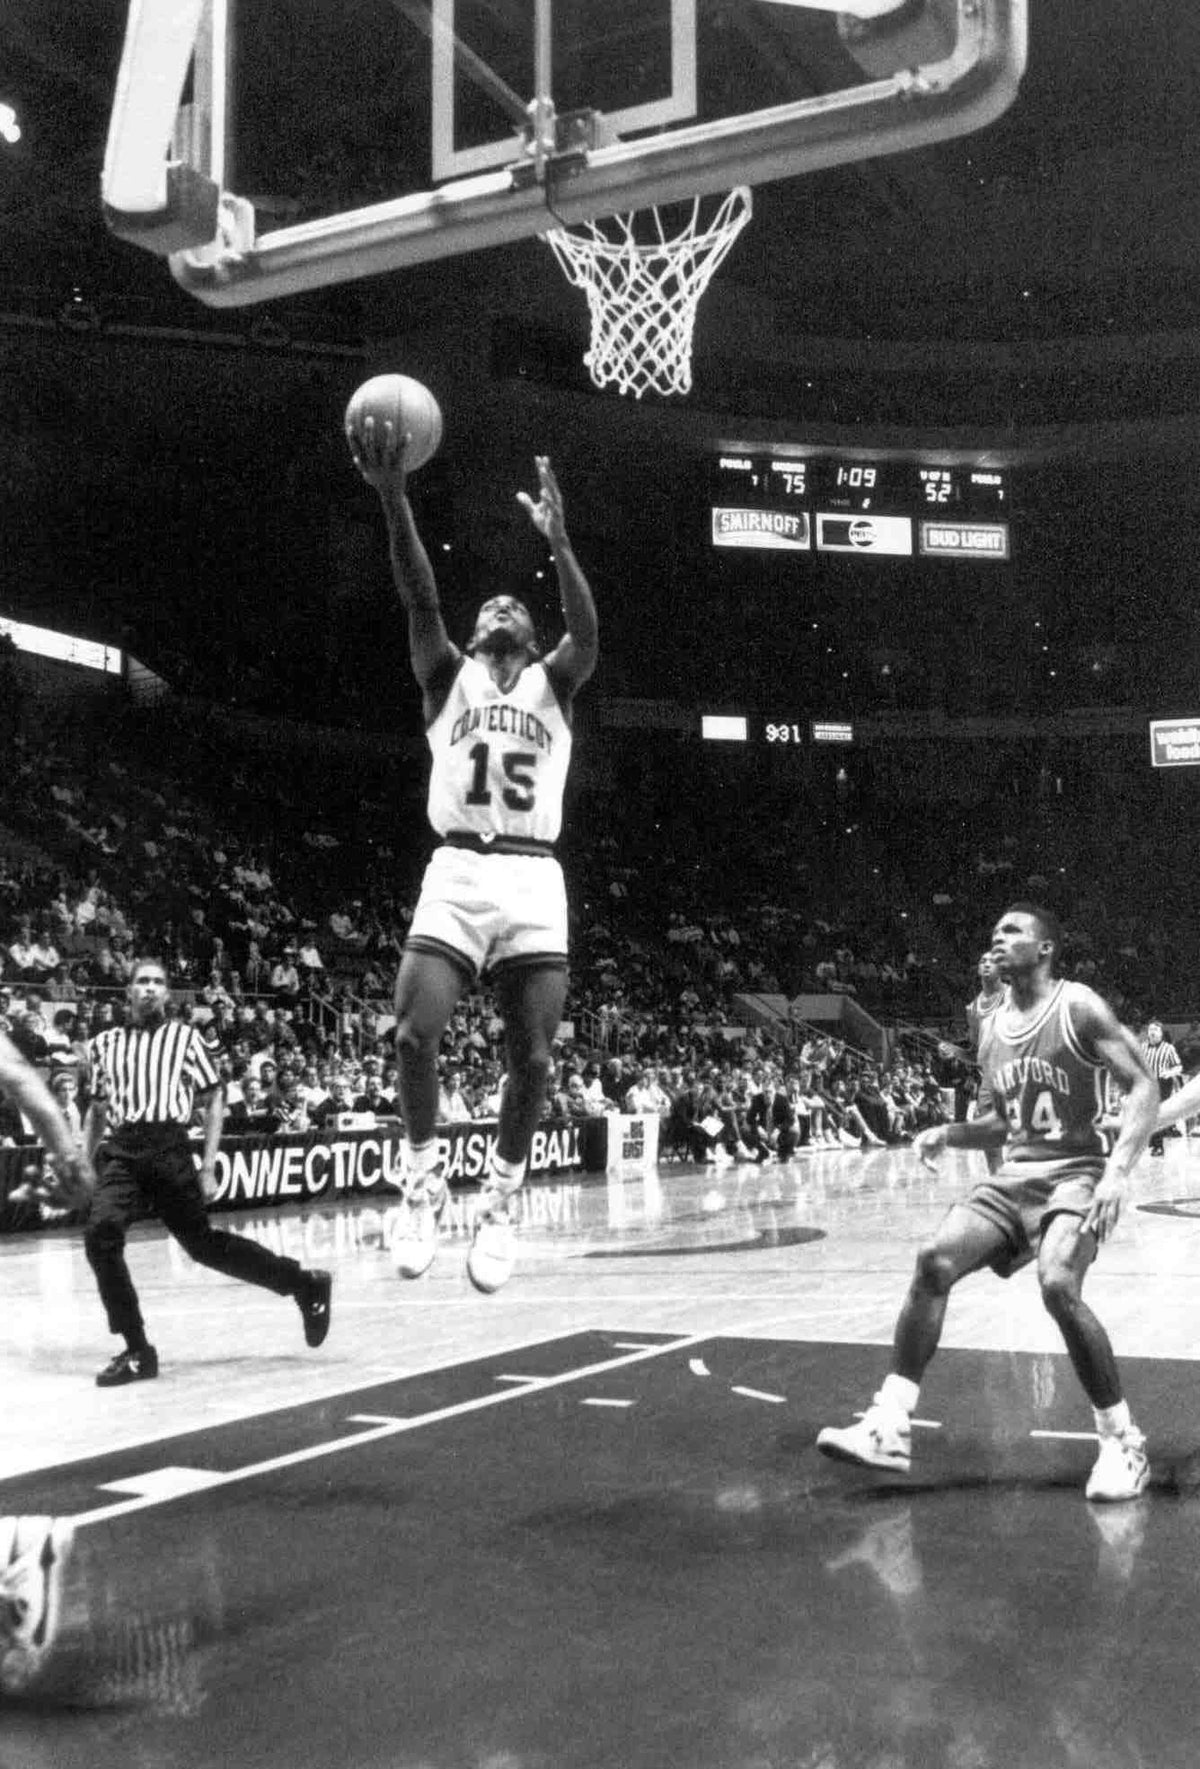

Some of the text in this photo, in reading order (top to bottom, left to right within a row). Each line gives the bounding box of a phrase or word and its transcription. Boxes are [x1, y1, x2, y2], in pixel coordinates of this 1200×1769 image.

[782, 474, 806, 494] 75
[837, 467, 876, 487] 1:09
[925, 483, 952, 502] 52
[720, 512, 800, 534] SMIRNOFF
[929, 529, 1001, 550] BUD LIGHT
[465, 742, 537, 812] 15
[193, 1127, 581, 1202] ONNECTICU BASKBALL
